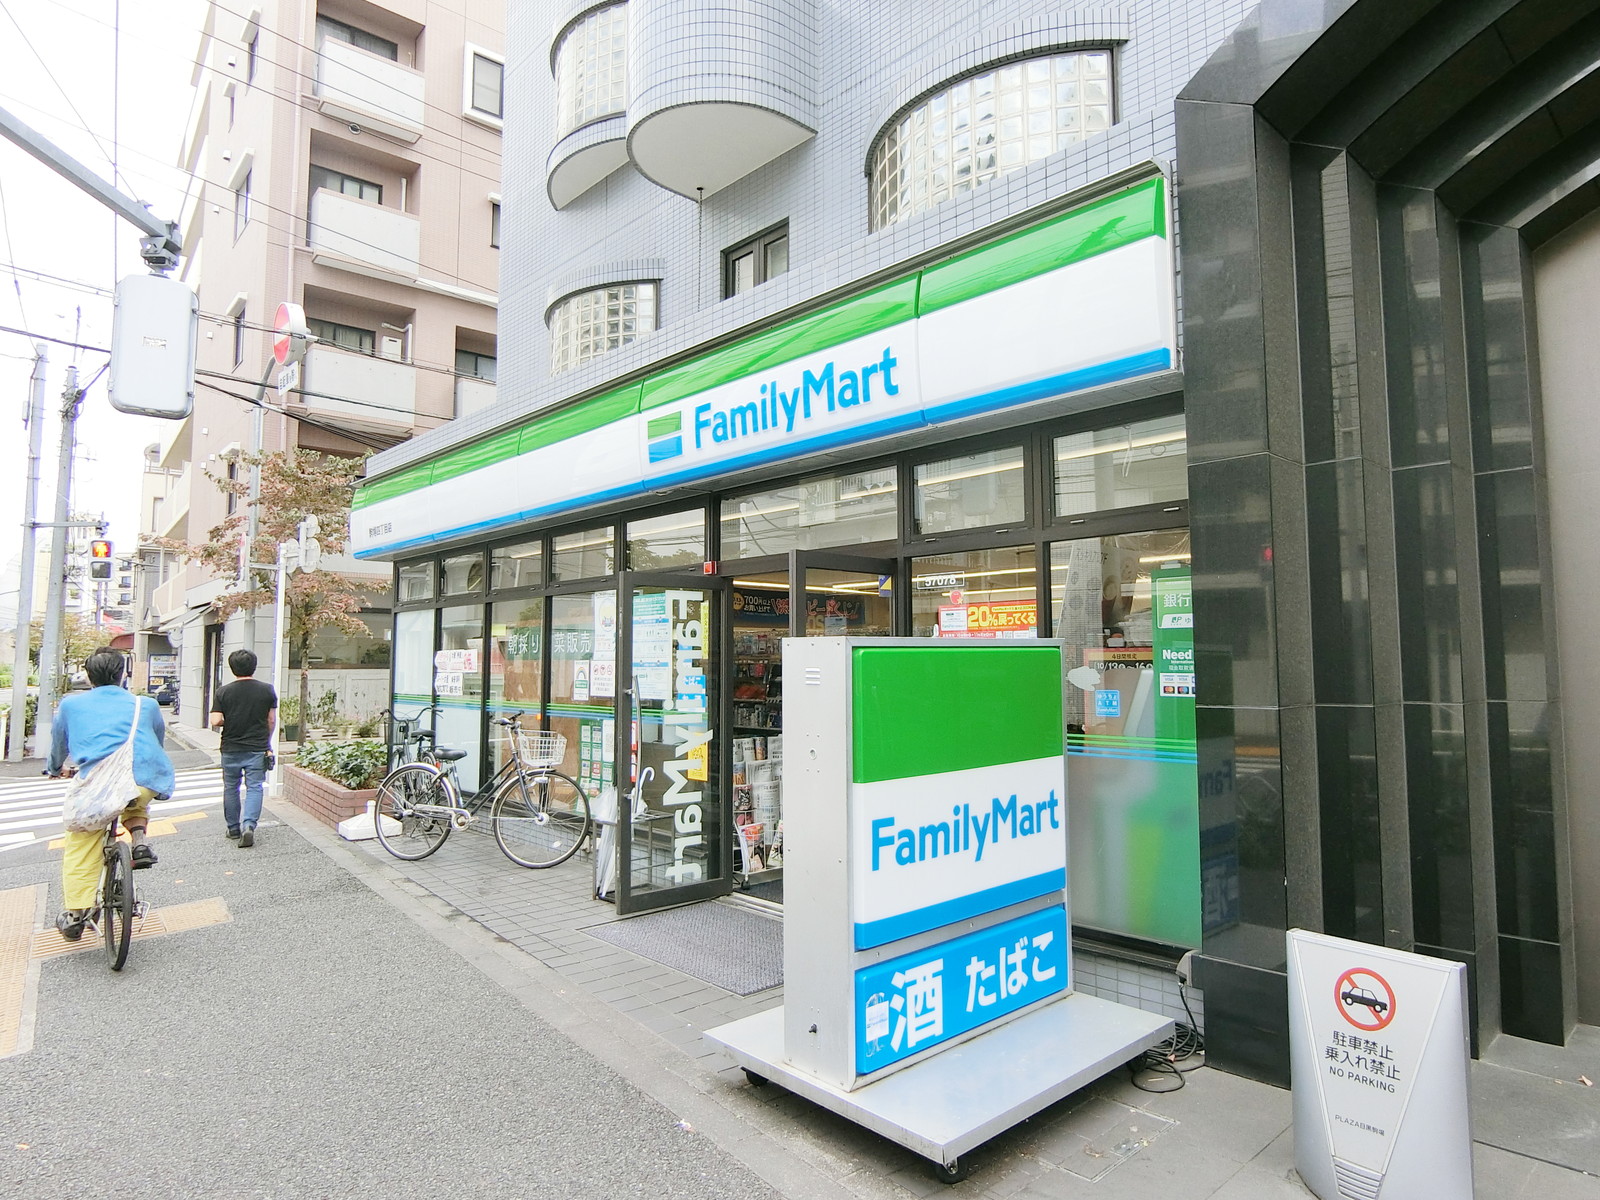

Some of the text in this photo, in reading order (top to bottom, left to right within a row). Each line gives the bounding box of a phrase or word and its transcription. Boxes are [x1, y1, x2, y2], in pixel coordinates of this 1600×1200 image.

[694, 346, 900, 449] FamilyMart
[1162, 649, 1192, 660] Need
[871, 789, 1059, 871] FamilyMart
[889, 930, 1057, 1053] 酒 たばこ
[1324, 1045, 1401, 1081] 乗入れ禁止
[1332, 1029, 1394, 1061] 駐車禁止
[1329, 1066, 1396, 1094] NO PARKING
